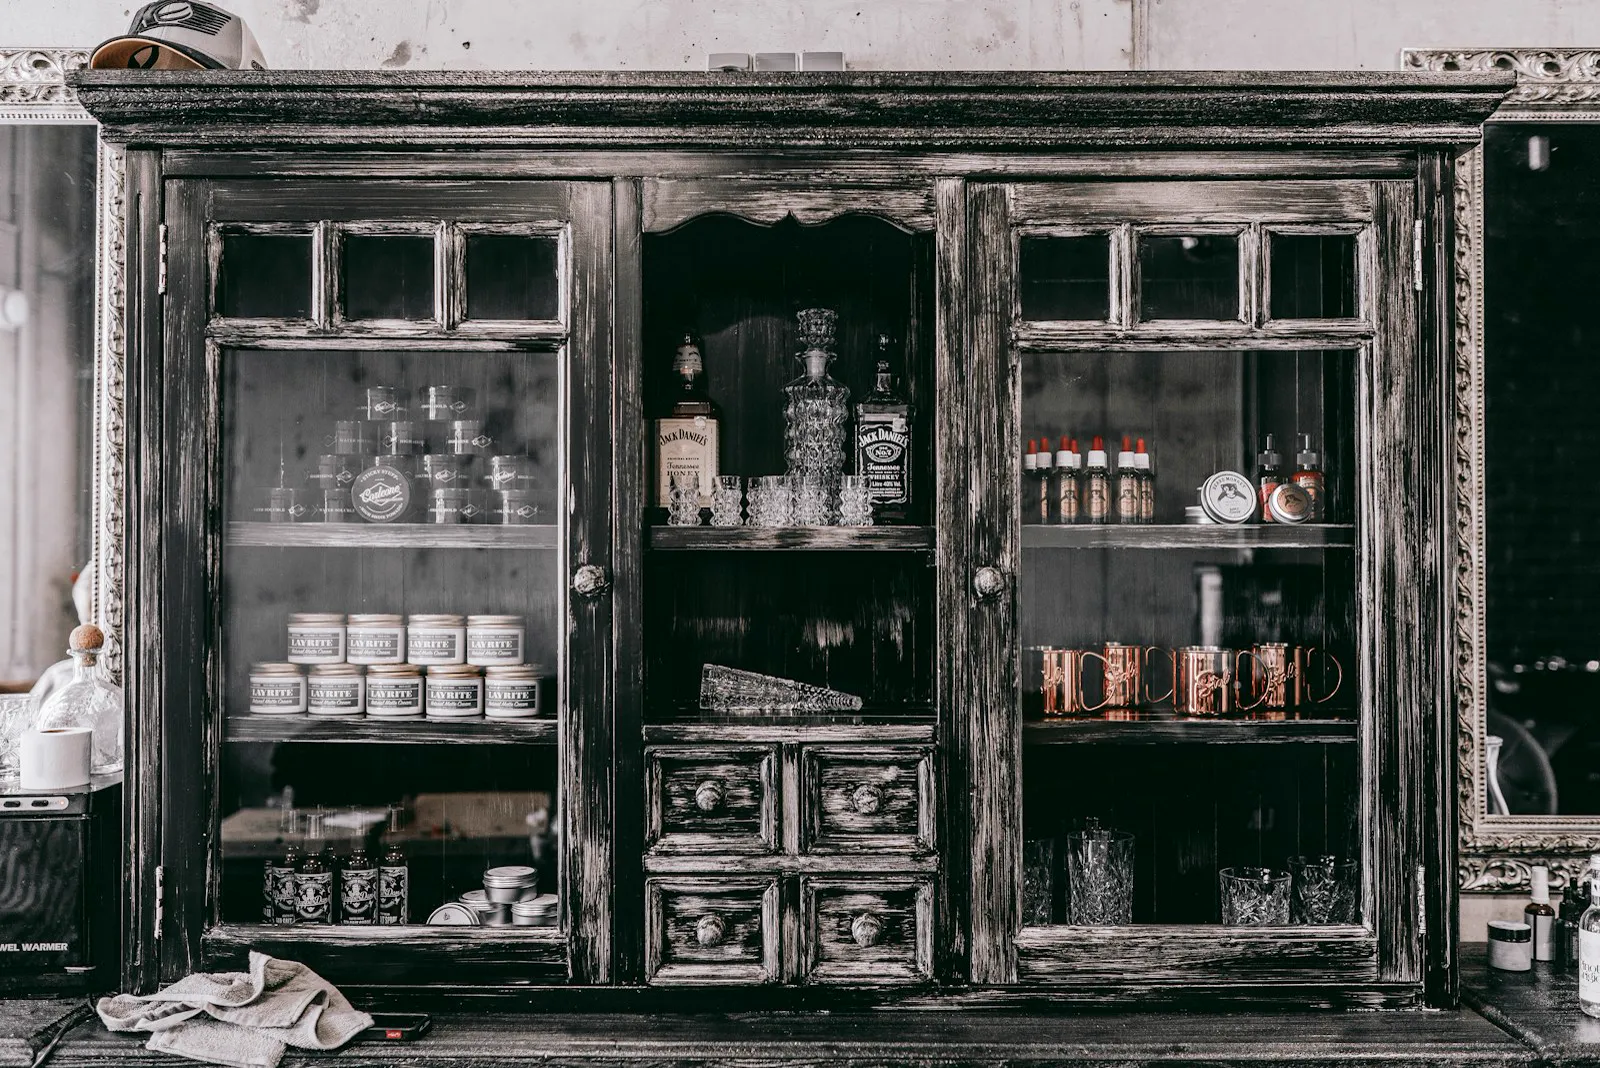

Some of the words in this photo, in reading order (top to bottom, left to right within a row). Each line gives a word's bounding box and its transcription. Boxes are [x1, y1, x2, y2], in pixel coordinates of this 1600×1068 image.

[660, 431, 678, 446] JACK
[679, 428, 708, 446] DANIEL'S
[859, 432, 878, 447] JACK
[878, 427, 909, 448] DANIEL'S
[667, 461, 700, 469] Tennessee
[867, 462, 900, 470] Tennessee
[291, 639, 333, 647] LAYRITE
[350, 640, 392, 648] LAYRITE
[409, 640, 449, 648] LAYRITE
[471, 640, 513, 648] LAYRITE
[252, 688, 293, 697] LAYRITE
[311, 689, 352, 698] LAYRITE
[370, 690, 413, 698] LAYRITE
[430, 691, 472, 699] LAYRITE
[488, 691, 530, 699] LAYRITE
[21, 943, 69, 952] WARMER
